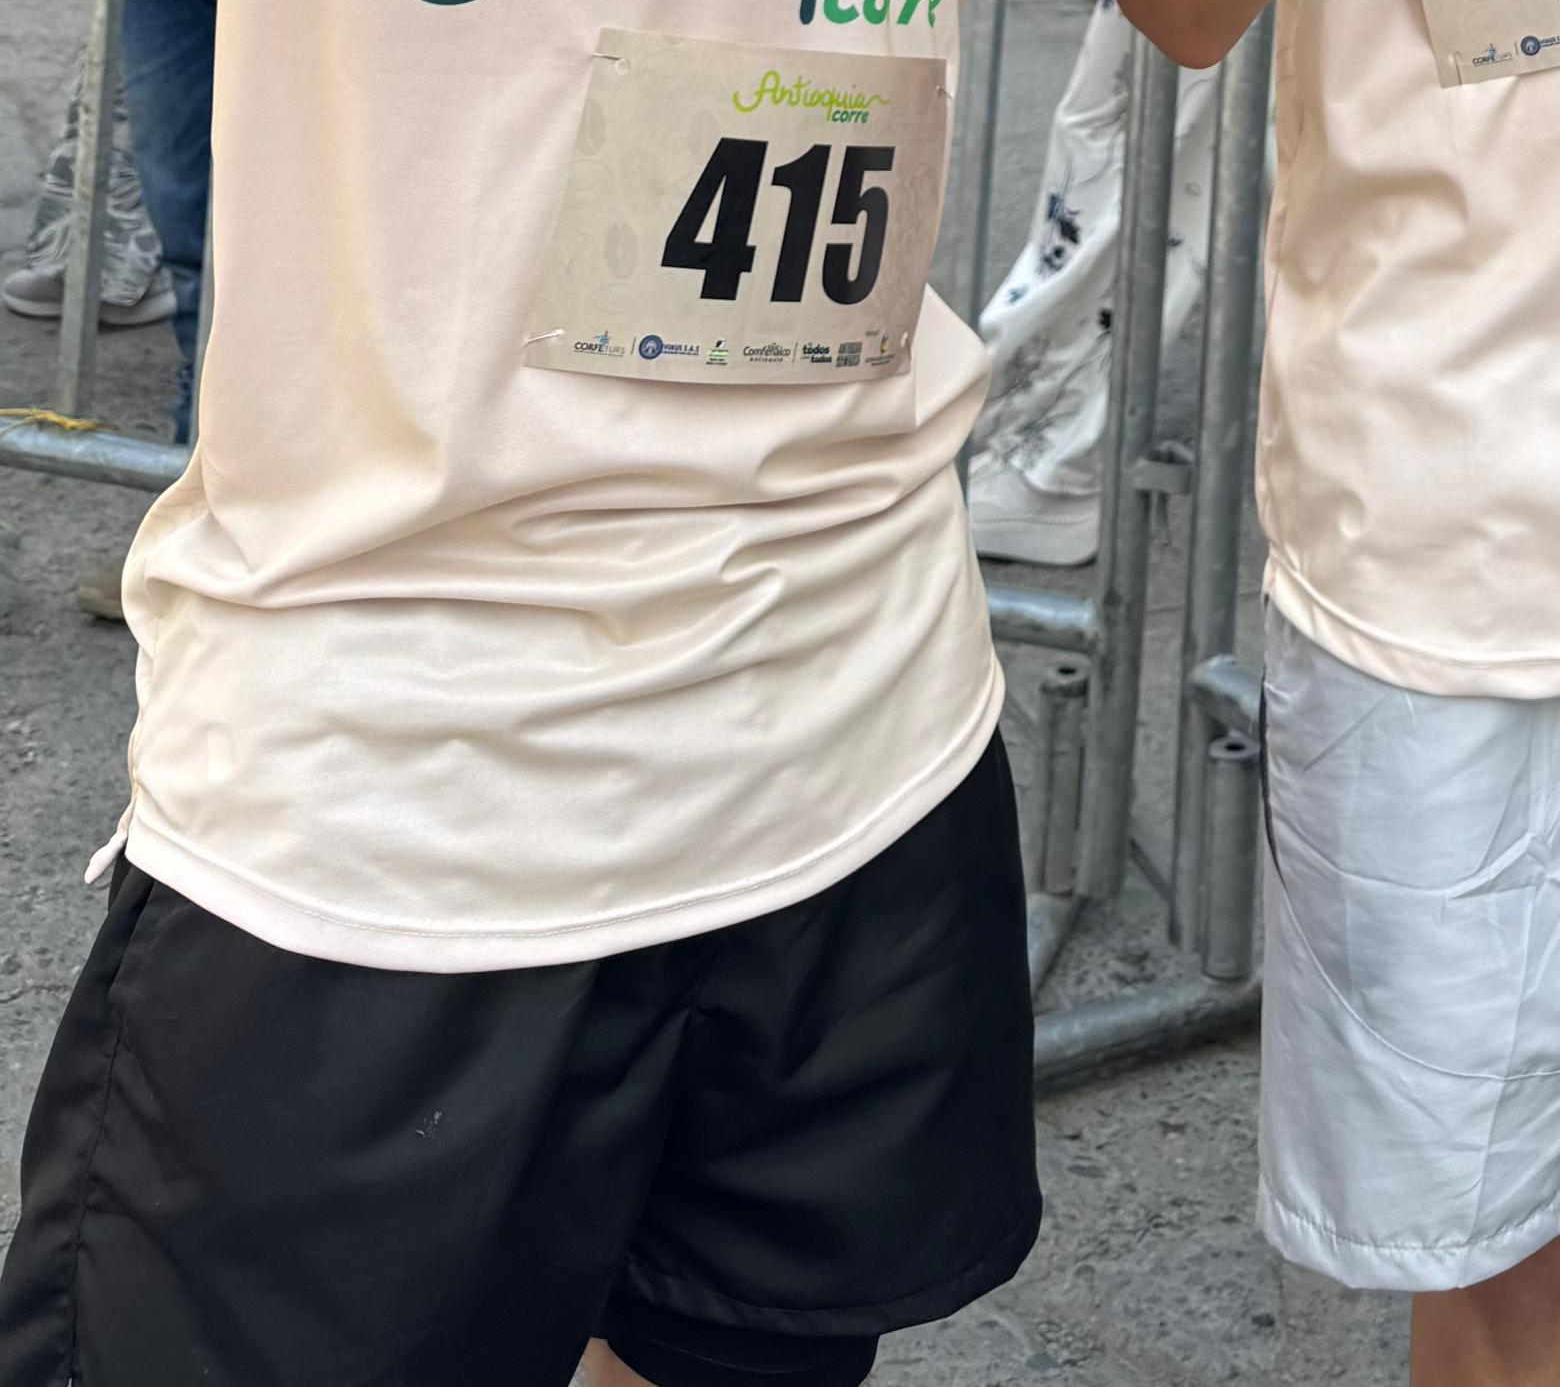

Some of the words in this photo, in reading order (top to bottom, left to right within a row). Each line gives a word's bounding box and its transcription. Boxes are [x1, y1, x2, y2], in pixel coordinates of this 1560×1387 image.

[731, 69, 892, 124] Antioquia
[830, 107, 870, 125] corre
[660, 136, 897, 306] 415
